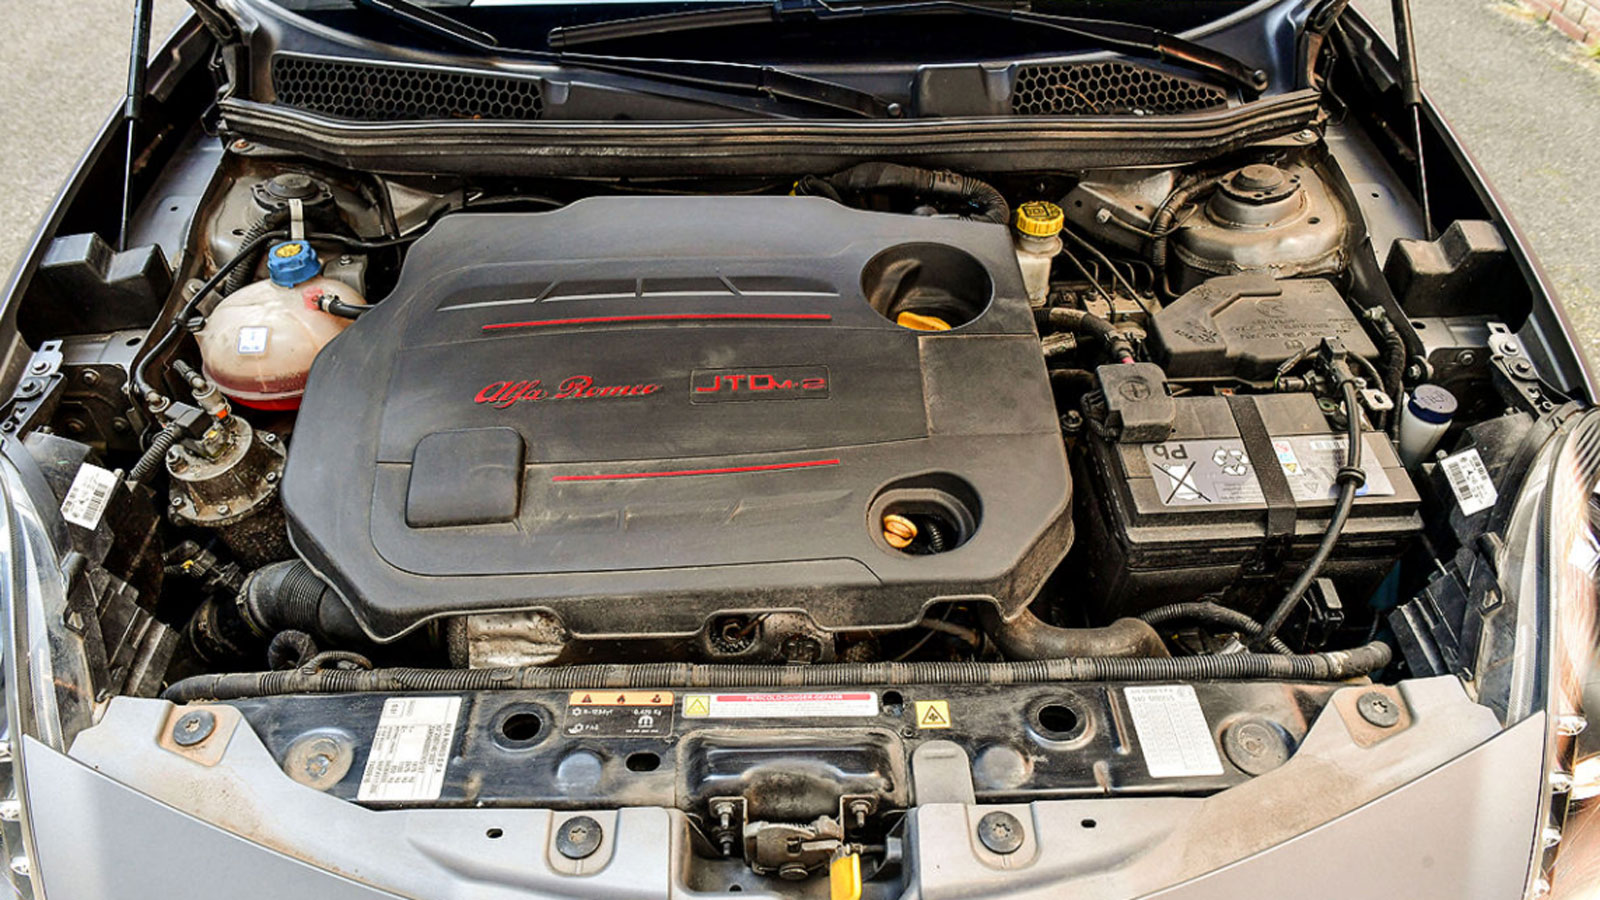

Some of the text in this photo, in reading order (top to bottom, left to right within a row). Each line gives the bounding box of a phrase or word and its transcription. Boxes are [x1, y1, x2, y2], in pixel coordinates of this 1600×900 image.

[474, 375, 661, 409] Alfa Romeo
[1152, 444, 1188, 460] Pb
